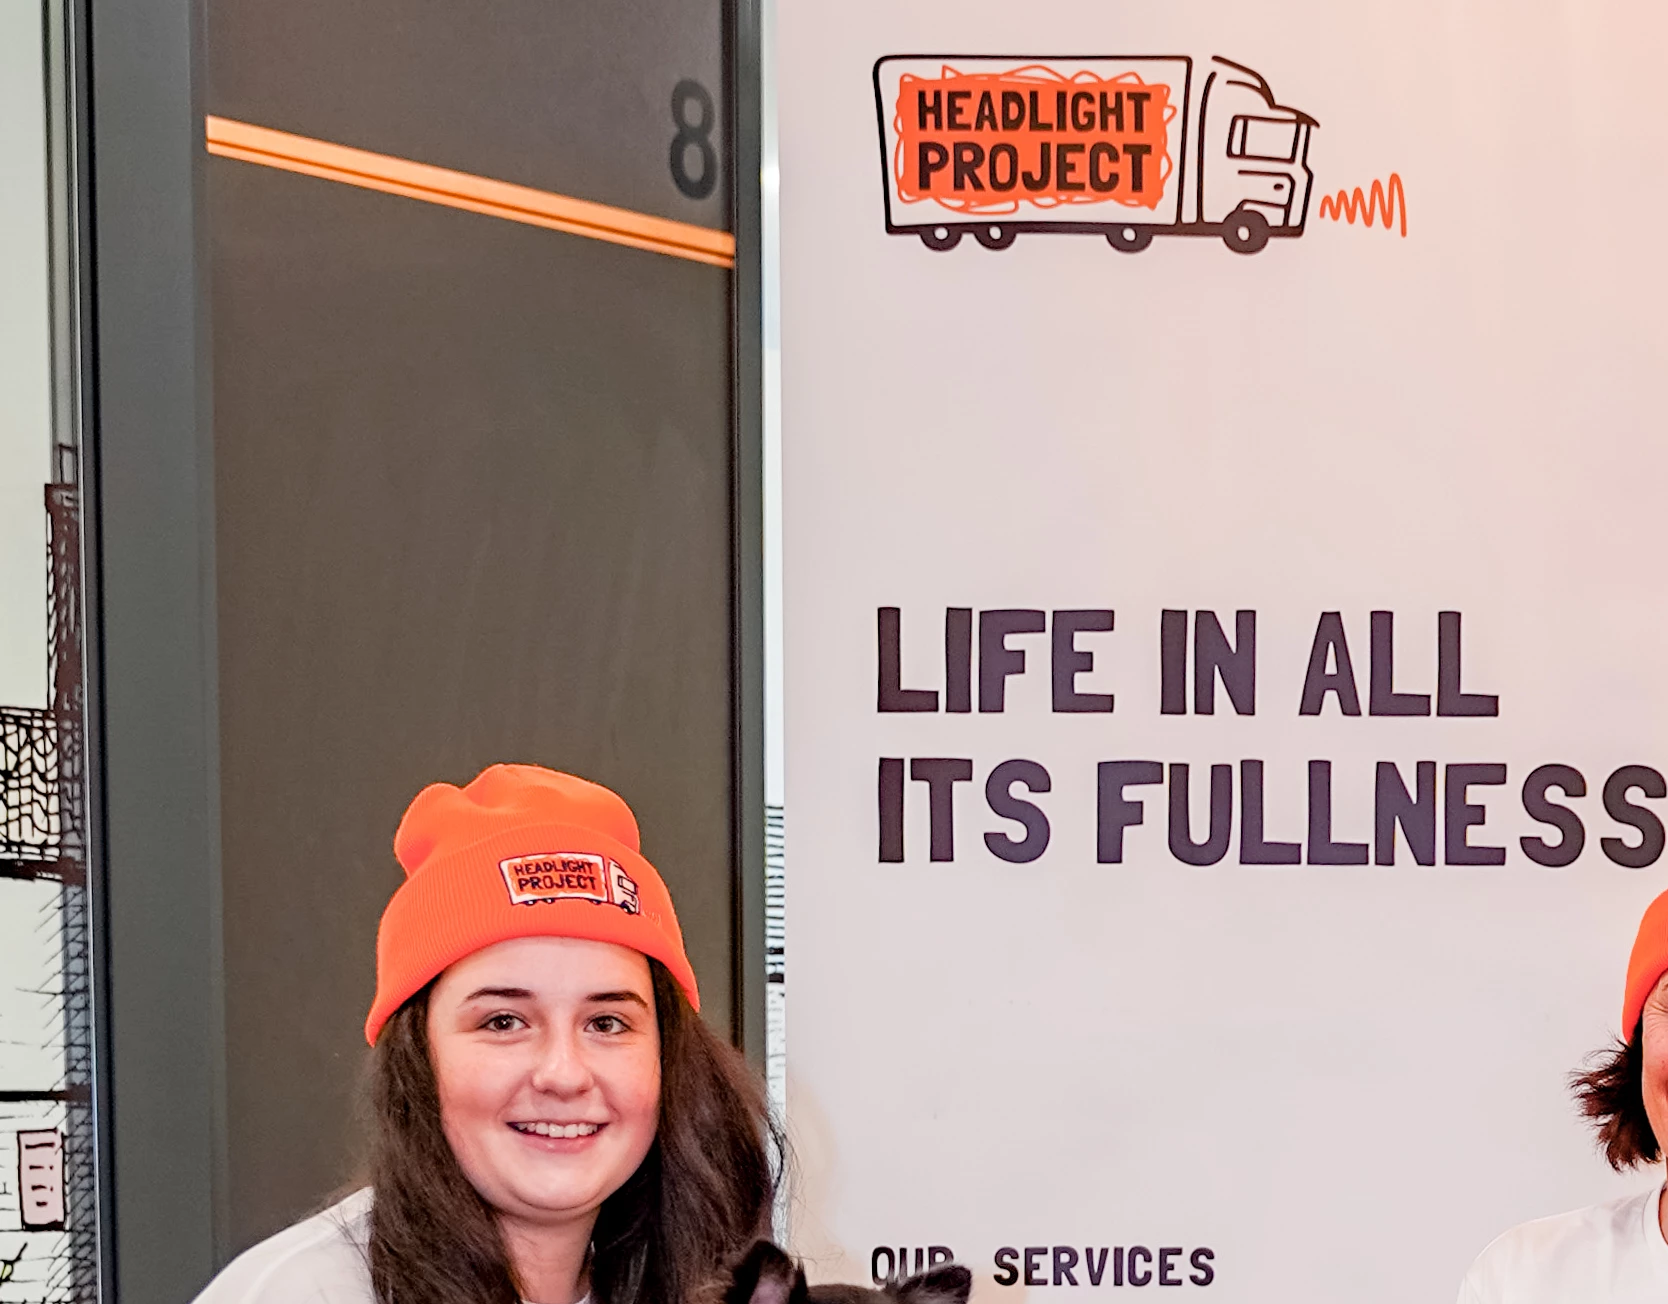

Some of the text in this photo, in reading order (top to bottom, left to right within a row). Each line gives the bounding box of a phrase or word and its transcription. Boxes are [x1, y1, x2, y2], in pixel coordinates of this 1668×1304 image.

[918, 90, 1151, 132] HEADLIGHT
[670, 78, 718, 201] 8
[917, 141, 1151, 193] PROJECT
[876, 606, 1500, 718] LIFE IN ALL
[877, 757, 1668, 868] ITS FULLNESS
[513, 860, 594, 877] HEADLIGHT
[517, 874, 597, 892] PROJECT
[993, 1246, 1216, 1287] SERVICES
